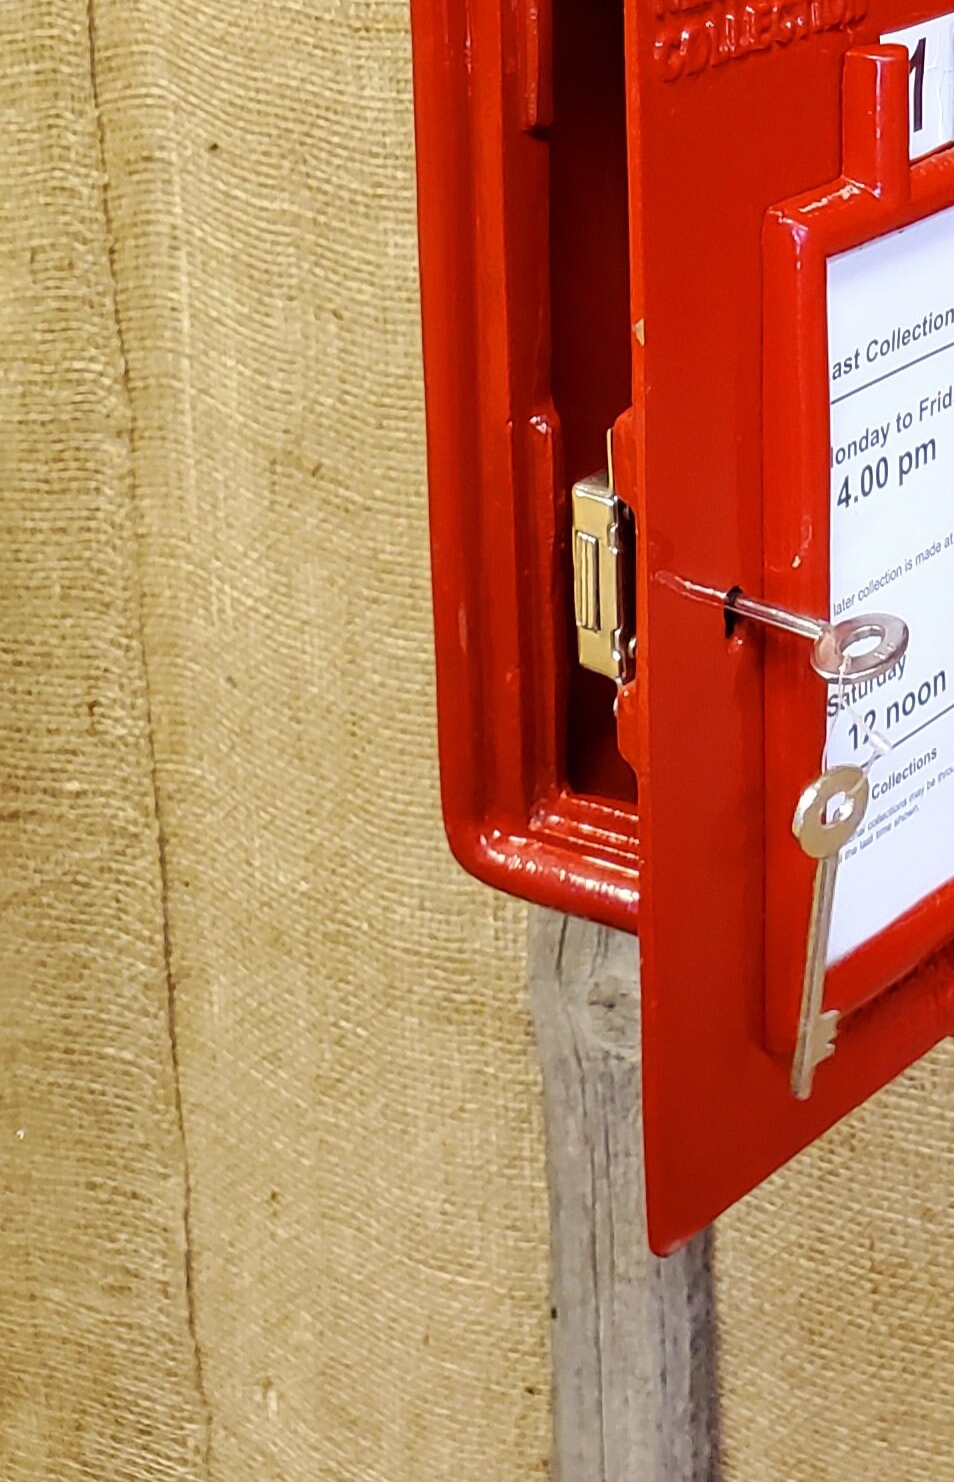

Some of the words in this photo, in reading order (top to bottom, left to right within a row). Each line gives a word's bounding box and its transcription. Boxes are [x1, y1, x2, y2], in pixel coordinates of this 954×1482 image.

[908, 37, 927, 133] 1
[832, 350, 860, 380] ast
[866, 307, 954, 362] Collection
[831, 422, 890, 468] onday
[896, 413, 913, 433] to
[836, 456, 889, 508] 4.00
[899, 438, 937, 486] pm
[833, 593, 855, 616] later
[857, 565, 902, 602] collection
[904, 558, 913, 571] is
[915, 541, 942, 565] made
[944, 532, 954, 549] at
[848, 709, 877, 751] 12
[886, 669, 947, 728] noon
[871, 747, 938, 800] Collections
